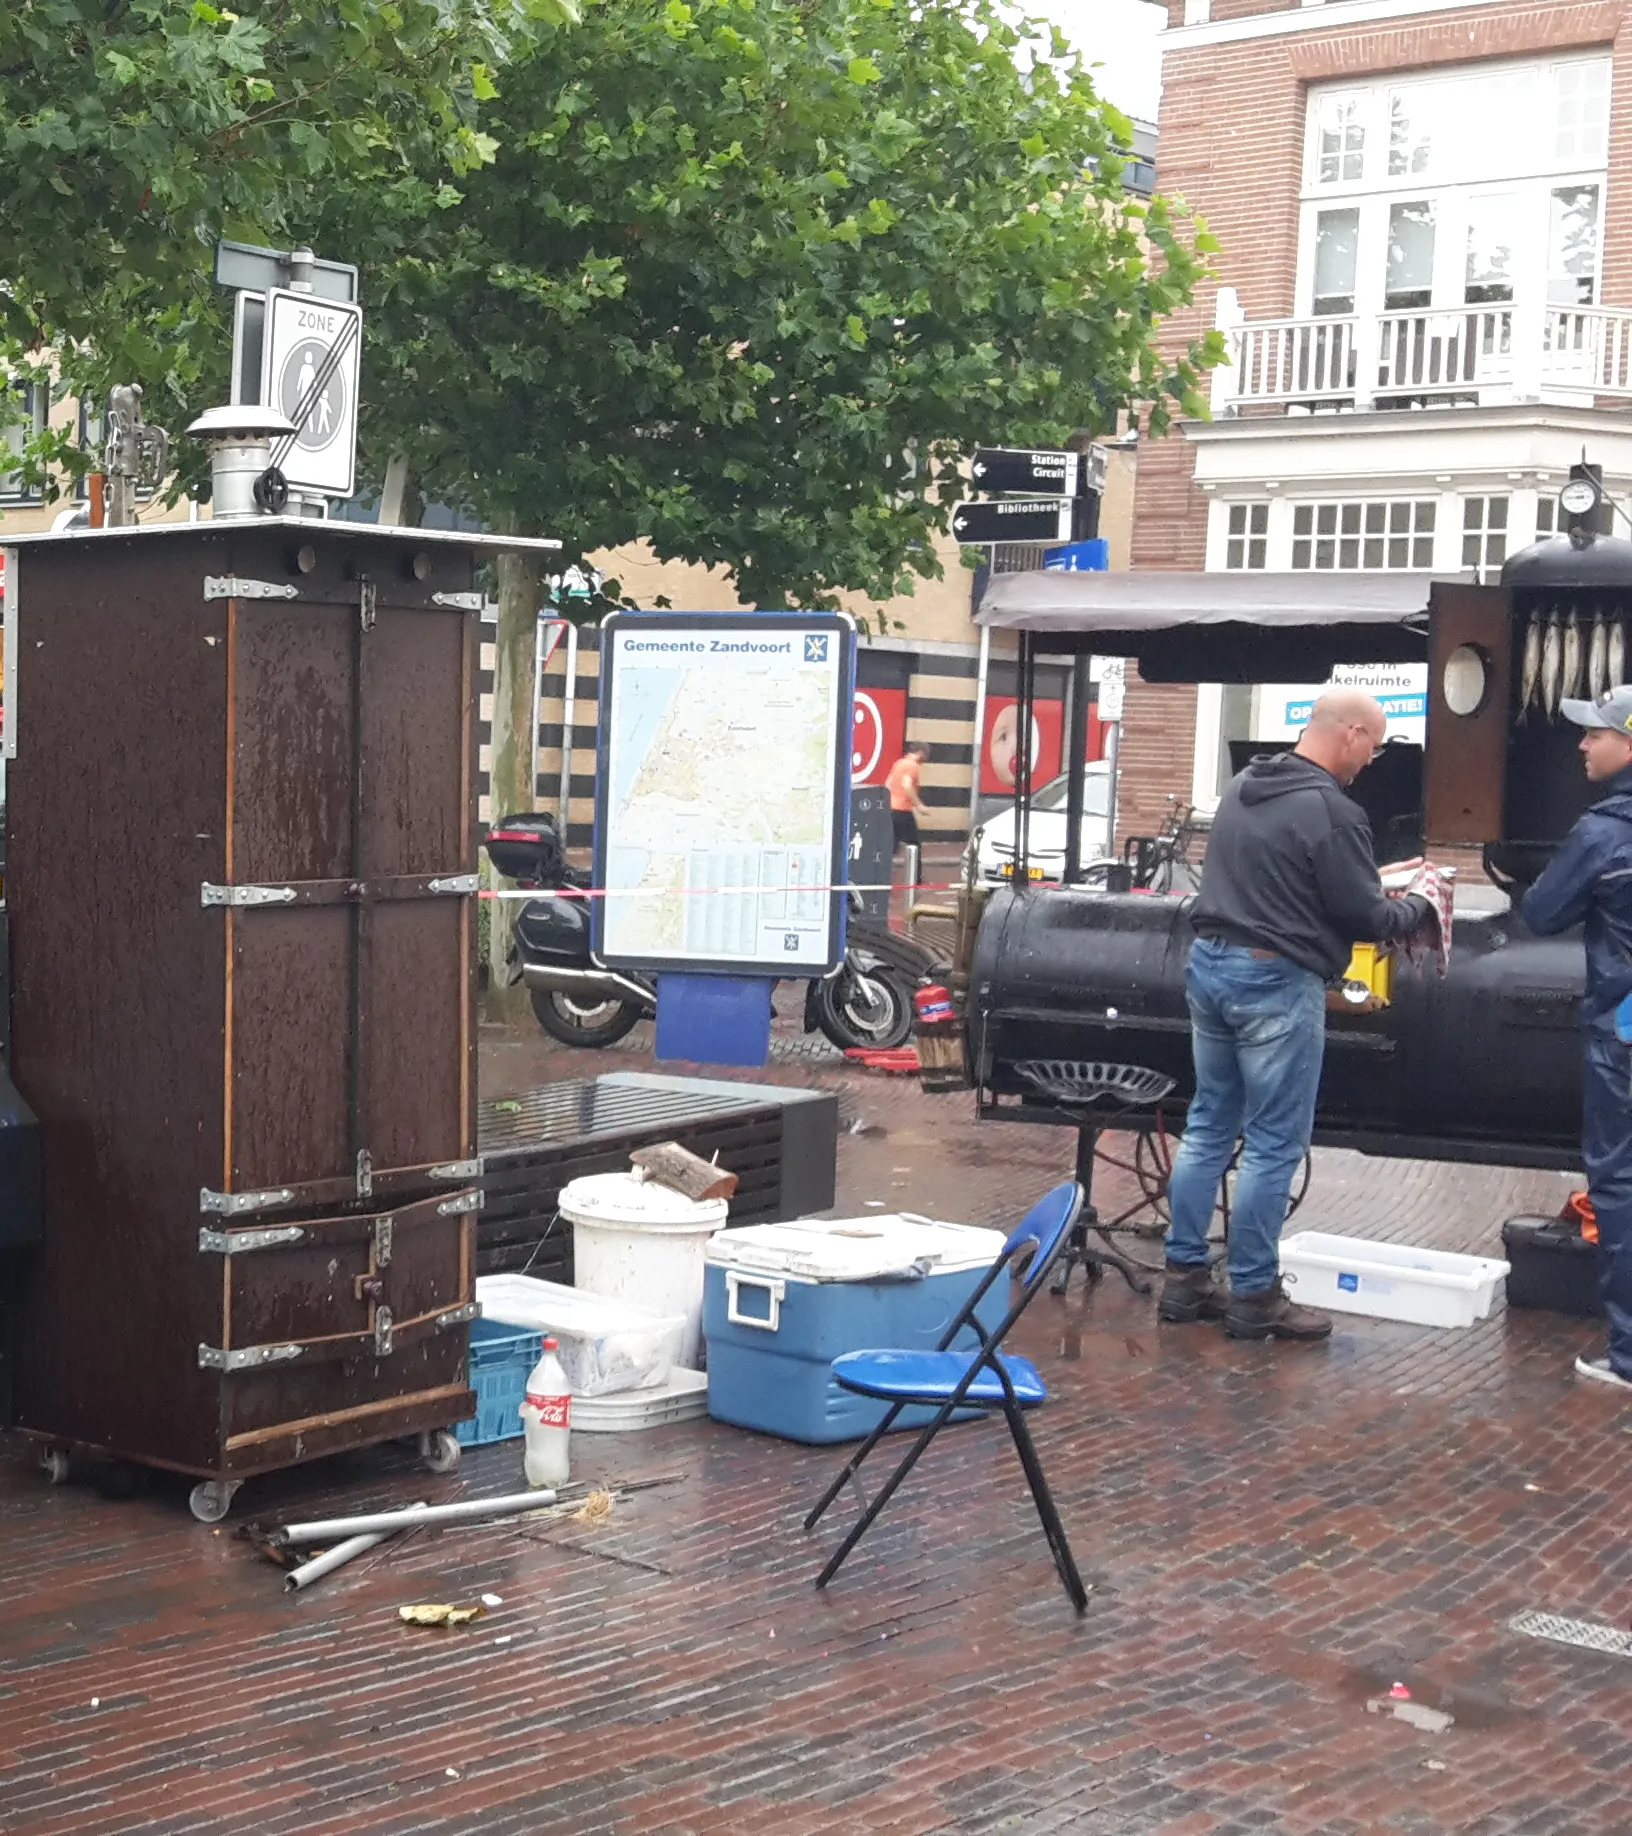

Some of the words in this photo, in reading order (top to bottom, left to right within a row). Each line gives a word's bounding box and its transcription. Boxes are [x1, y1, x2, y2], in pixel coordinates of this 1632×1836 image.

[298, 310, 335, 333] ZONE
[1031, 455, 1066, 466] Station
[1032, 467, 1065, 478] Circuit
[997, 502, 1059, 514] Bibliotheek
[623, 639, 706, 652] Gemeente
[709, 640, 792, 653] Zandvoort
